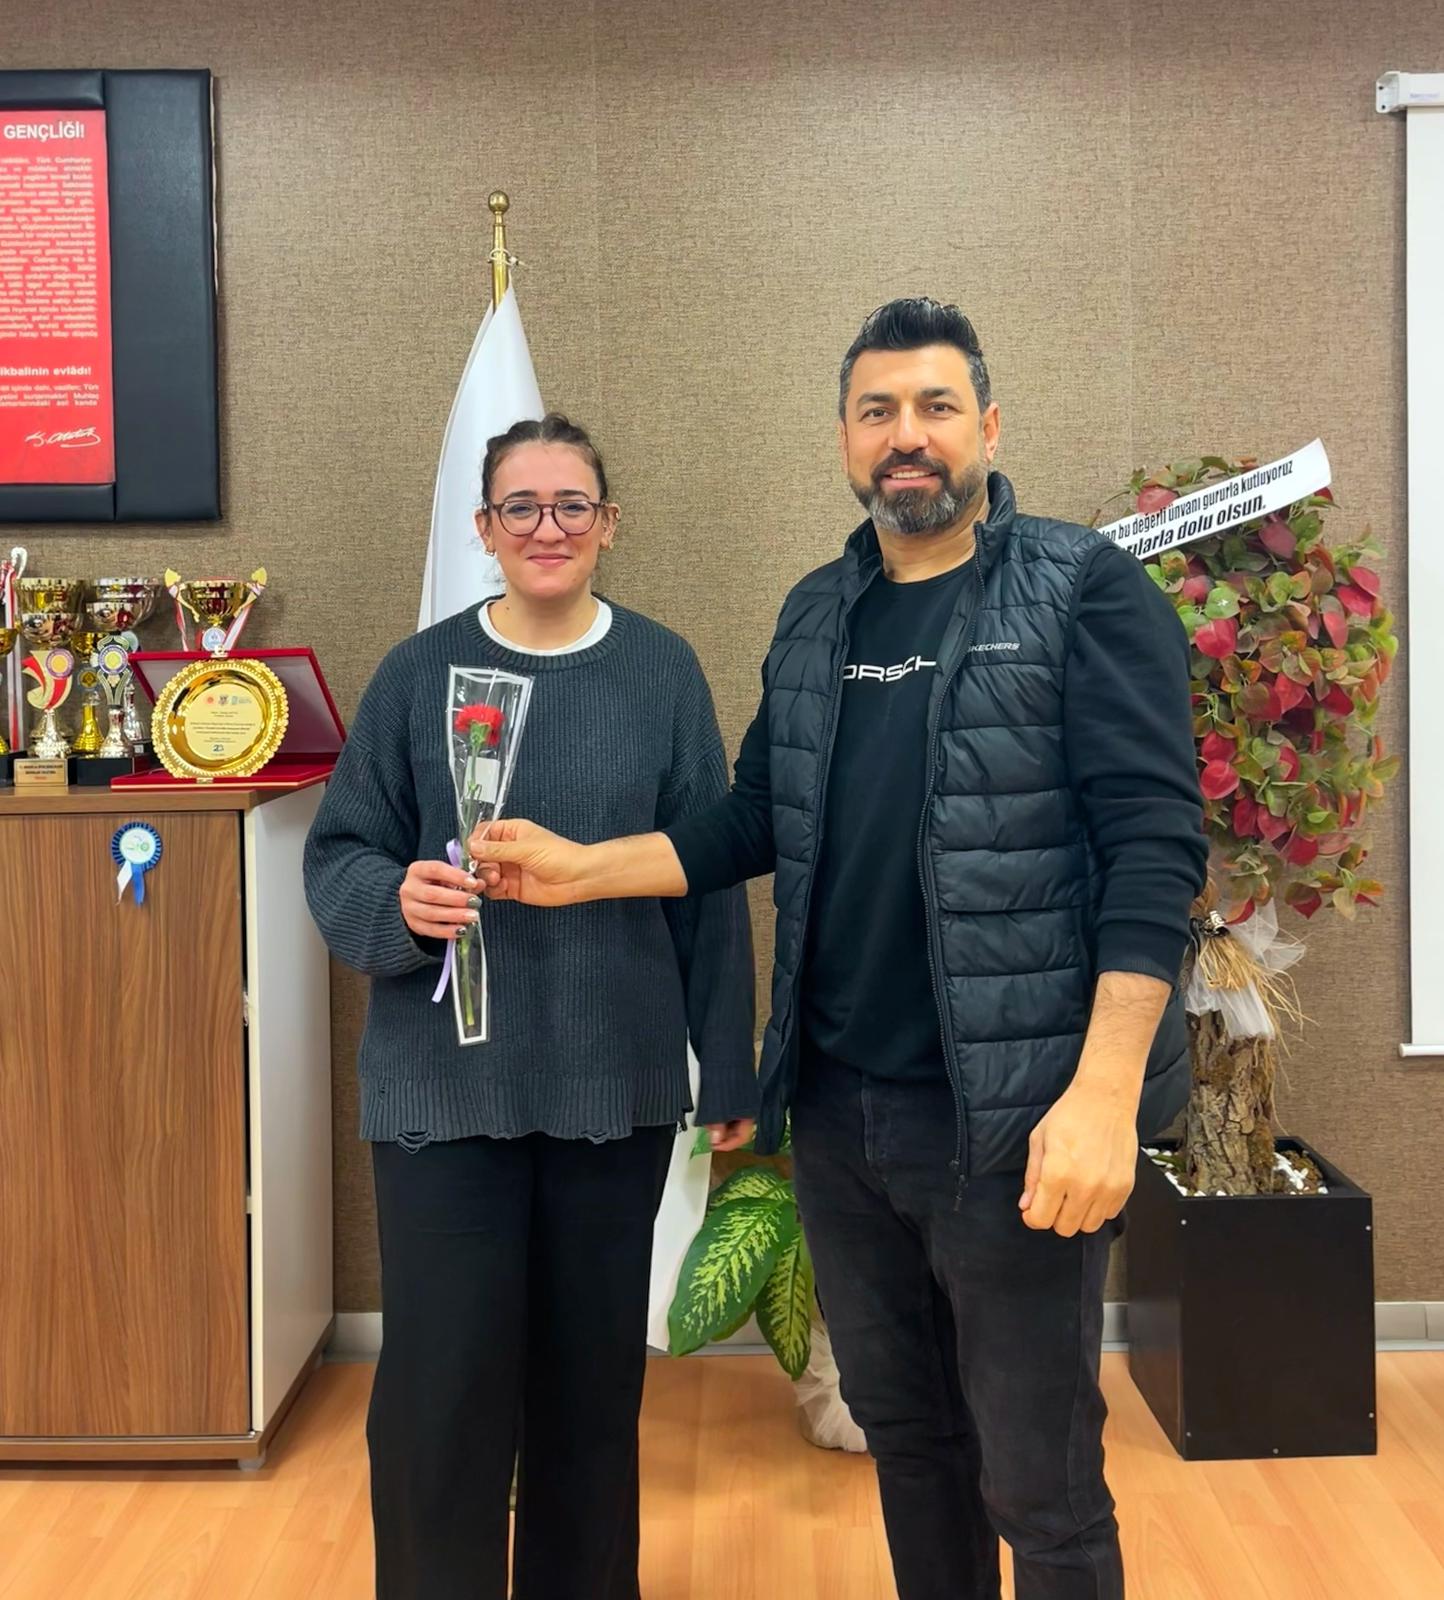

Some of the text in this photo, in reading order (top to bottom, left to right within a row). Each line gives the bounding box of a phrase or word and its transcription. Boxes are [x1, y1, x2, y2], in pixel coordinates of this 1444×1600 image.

[4, 121, 85, 142] GENÇLİĞİ!
[1118, 524, 1131, 539] bu
[1132, 507, 1168, 535] değerli
[1169, 497, 1201, 522] ünvanı
[1203, 482, 1240, 510] gururla
[1241, 460, 1293, 493] kutluyoruz
[1177, 515, 1213, 541] dolu
[1216, 495, 1266, 525] olsun.
